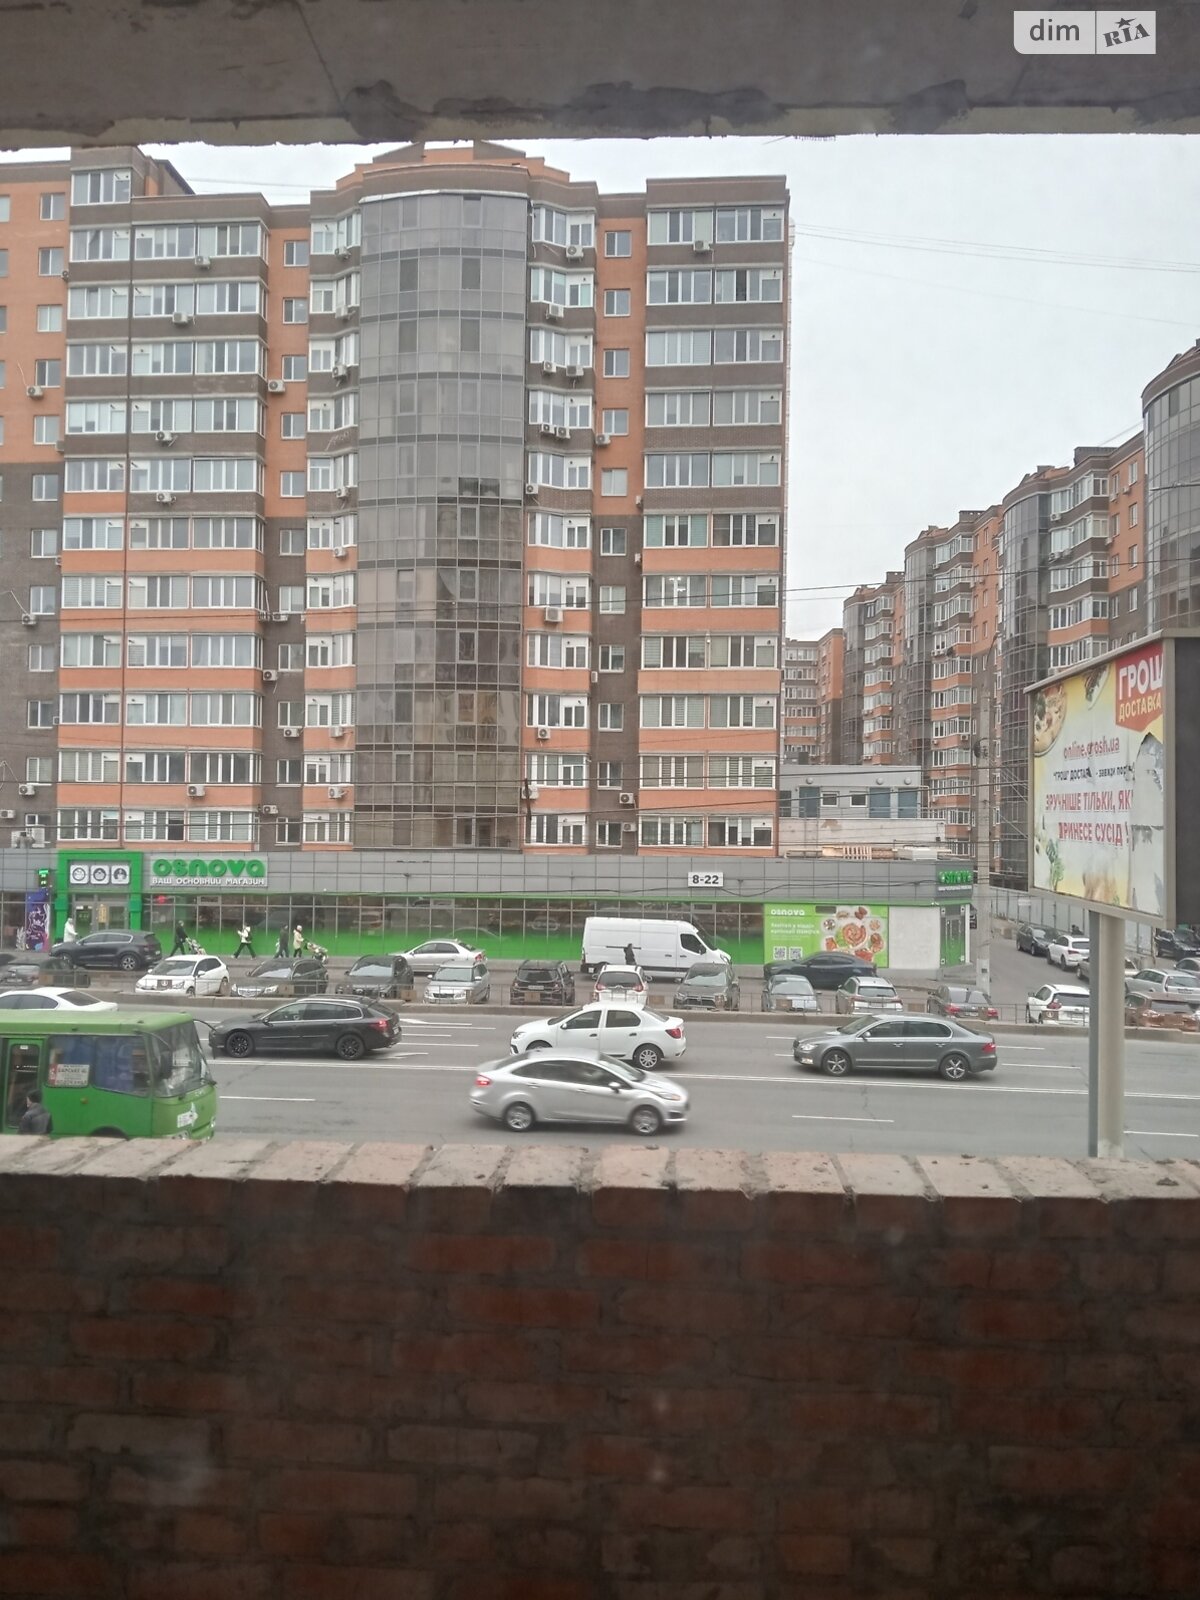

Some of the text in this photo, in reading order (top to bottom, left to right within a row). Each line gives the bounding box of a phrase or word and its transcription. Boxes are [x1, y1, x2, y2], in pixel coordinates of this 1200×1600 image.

[1119, 692, 1161, 722] ДОСТАВКА
[153, 858, 266, 878] osnova
[152, 877, 172, 885] ВАШ
[225, 877, 265, 886] МАГАЗИН
[692, 874, 719, 885] 8-22
